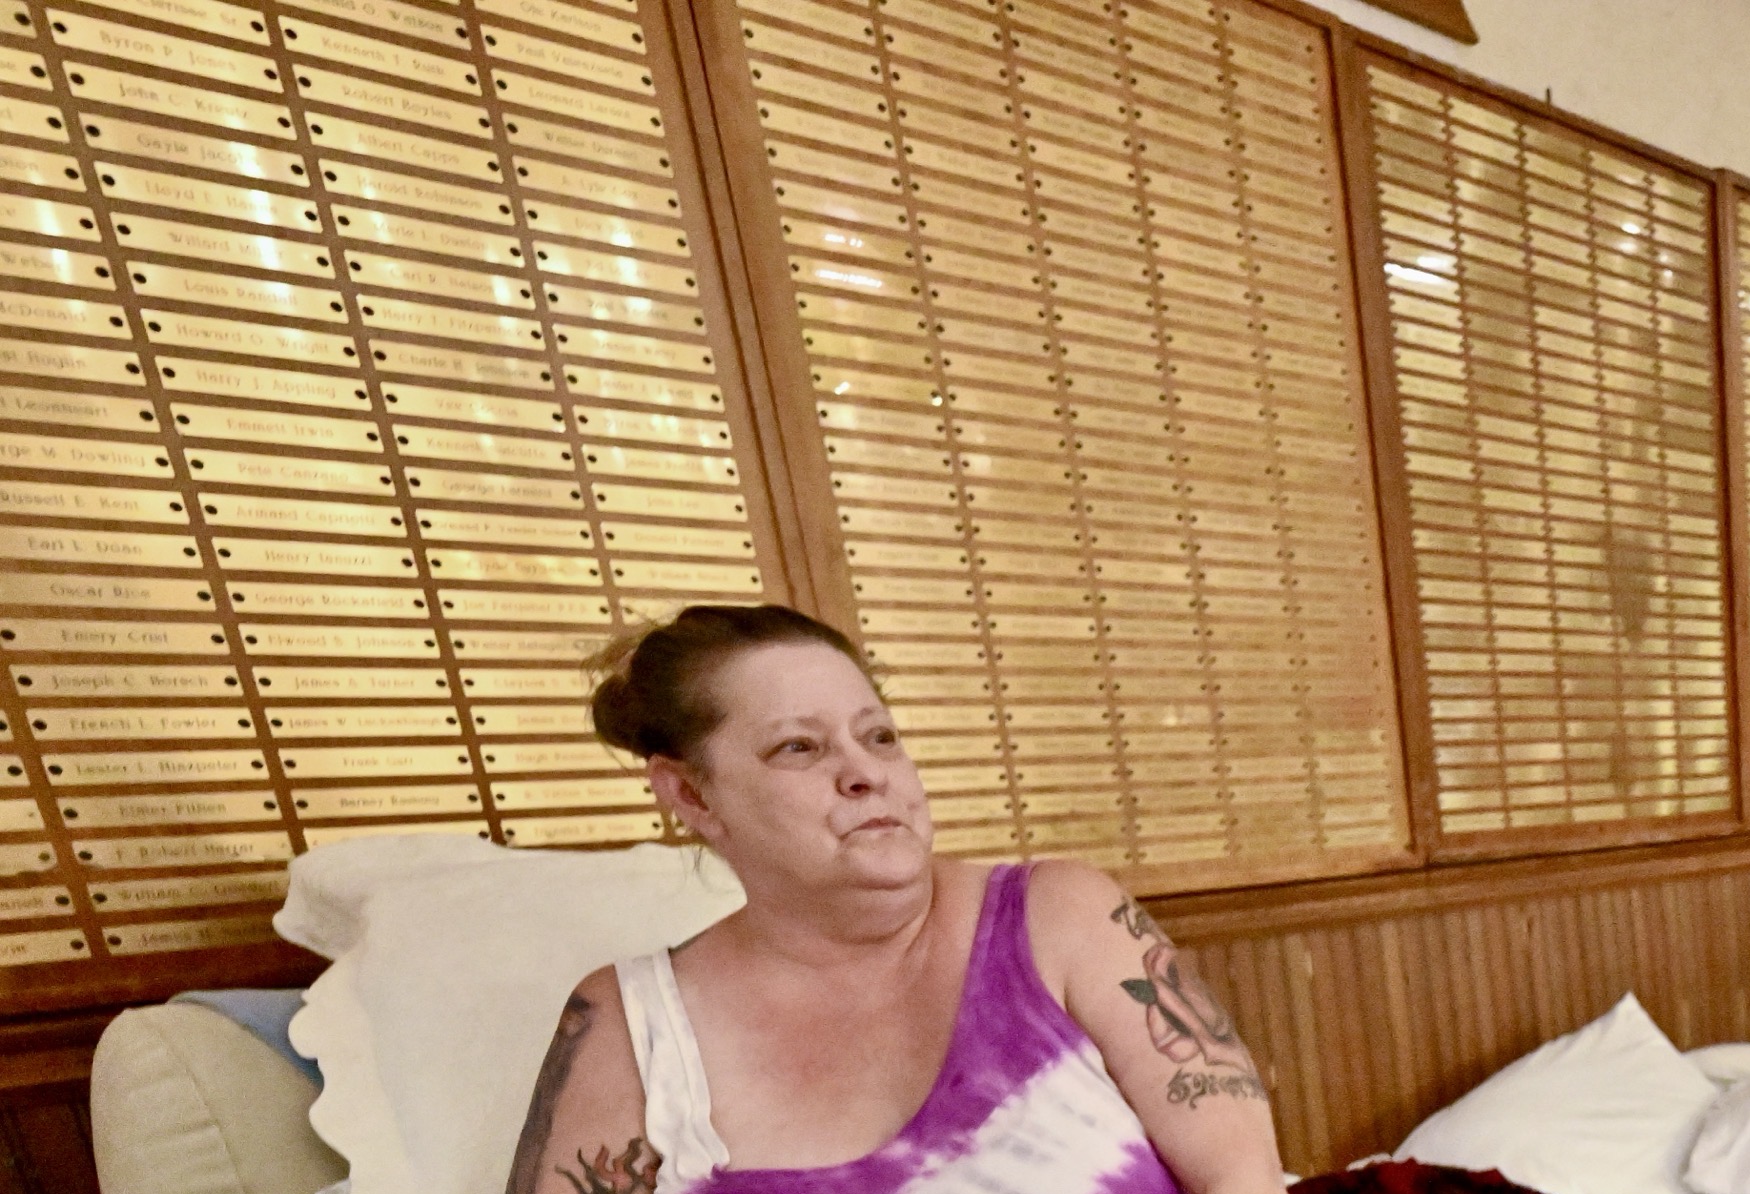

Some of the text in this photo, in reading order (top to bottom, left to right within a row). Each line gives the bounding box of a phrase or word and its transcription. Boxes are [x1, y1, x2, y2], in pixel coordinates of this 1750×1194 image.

[99, 28, 153, 56] Byron
[189, 49, 235, 74] Jones
[322, 36, 384, 62] Kenneth
[117, 81, 158, 105] John
[359, 131, 402, 154] Albert
[145, 179, 194, 203] Lloyd
[168, 229, 229, 253] Willard
[184, 277, 228, 298] Louis
[176, 322, 241, 344] Howard
[276, 336, 328, 356] Wright
[196, 368, 239, 388] Harry
[273, 377, 335, 402] Appling
[294, 424, 333, 439] Irwin
[71, 448, 145, 467] Dowling
[99, 495, 138, 512] Kent
[236, 505, 297, 521] Armand
[27, 536, 63, 552] Earl
[264, 549, 309, 564] Henry
[255, 592, 314, 607] George
[51, 674, 114, 690] Joseph
[294, 675, 340, 690] James
[69, 717, 130, 730] French
[160, 716, 216, 729] Fowler
[288, 718, 328, 729] James
